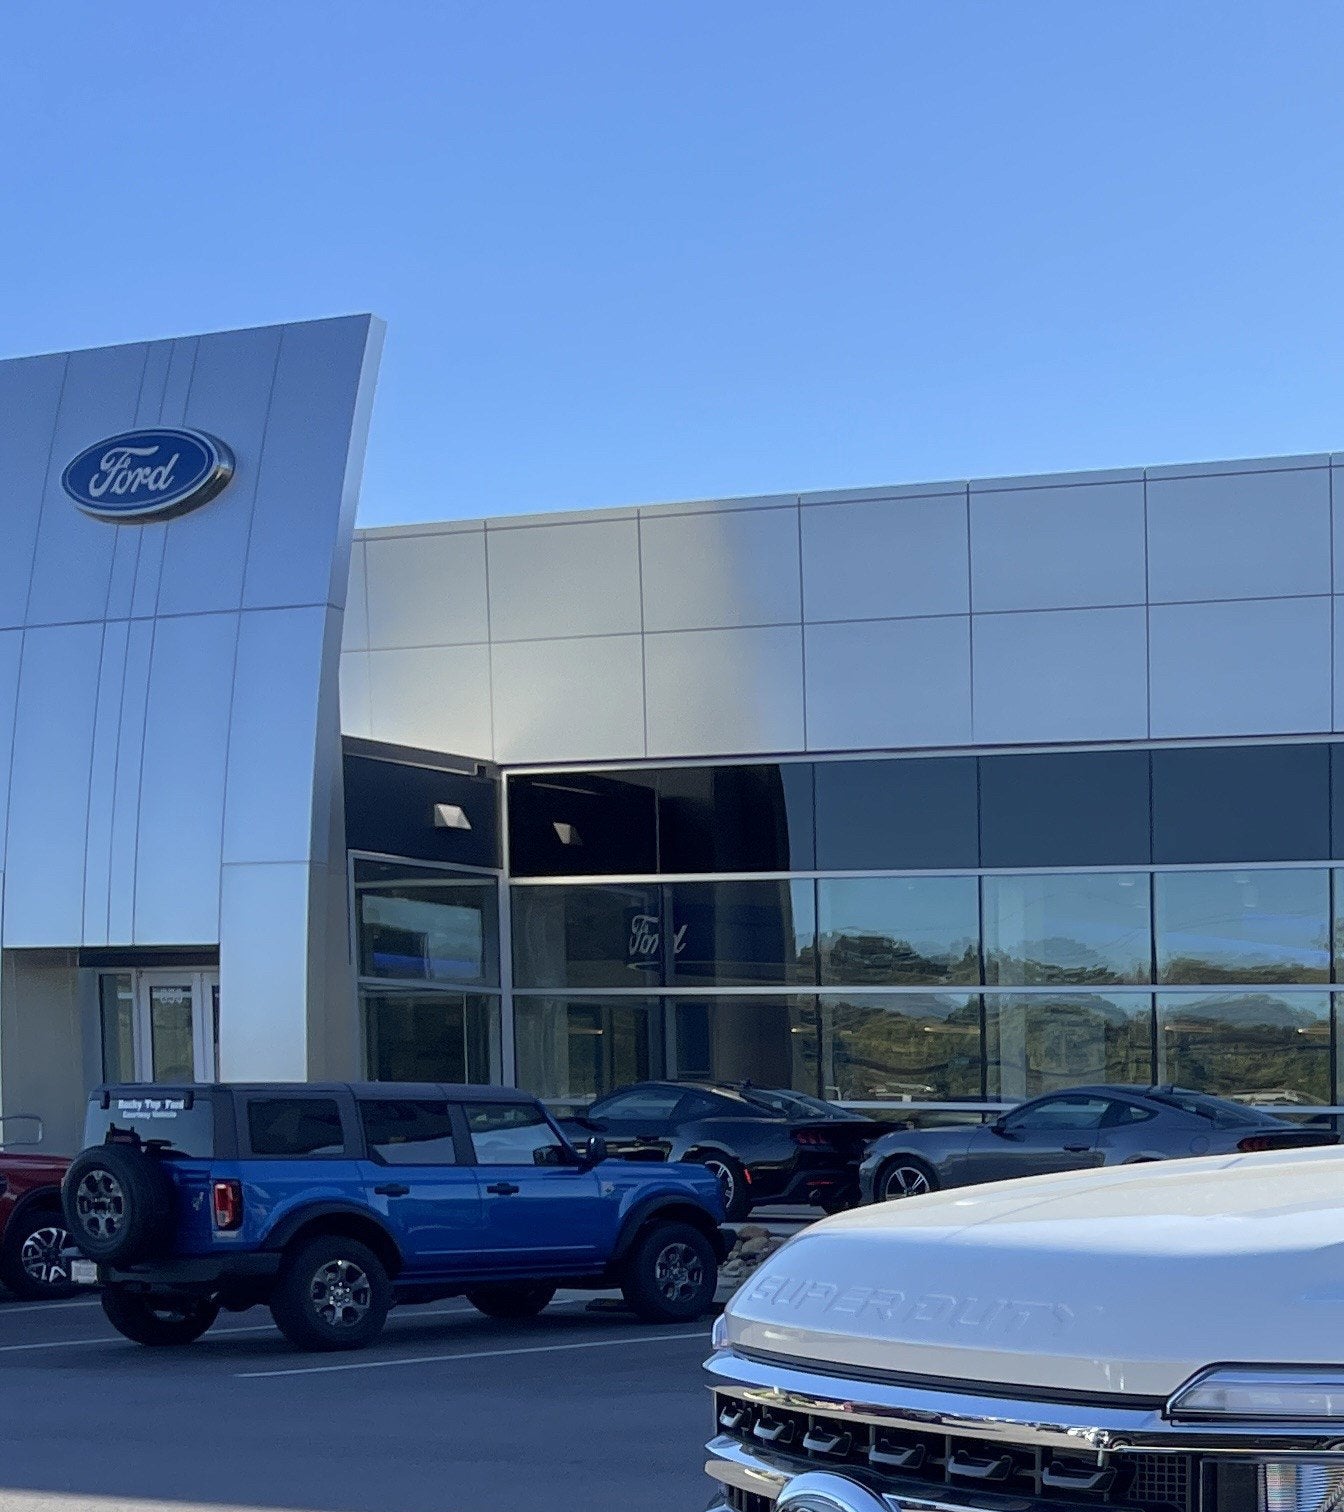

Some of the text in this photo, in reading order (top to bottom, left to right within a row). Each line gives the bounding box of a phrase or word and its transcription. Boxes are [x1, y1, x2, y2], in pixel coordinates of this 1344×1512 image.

[89, 445, 180, 498] Ford
[749, 1275, 1076, 1336] SUPER DUTY
